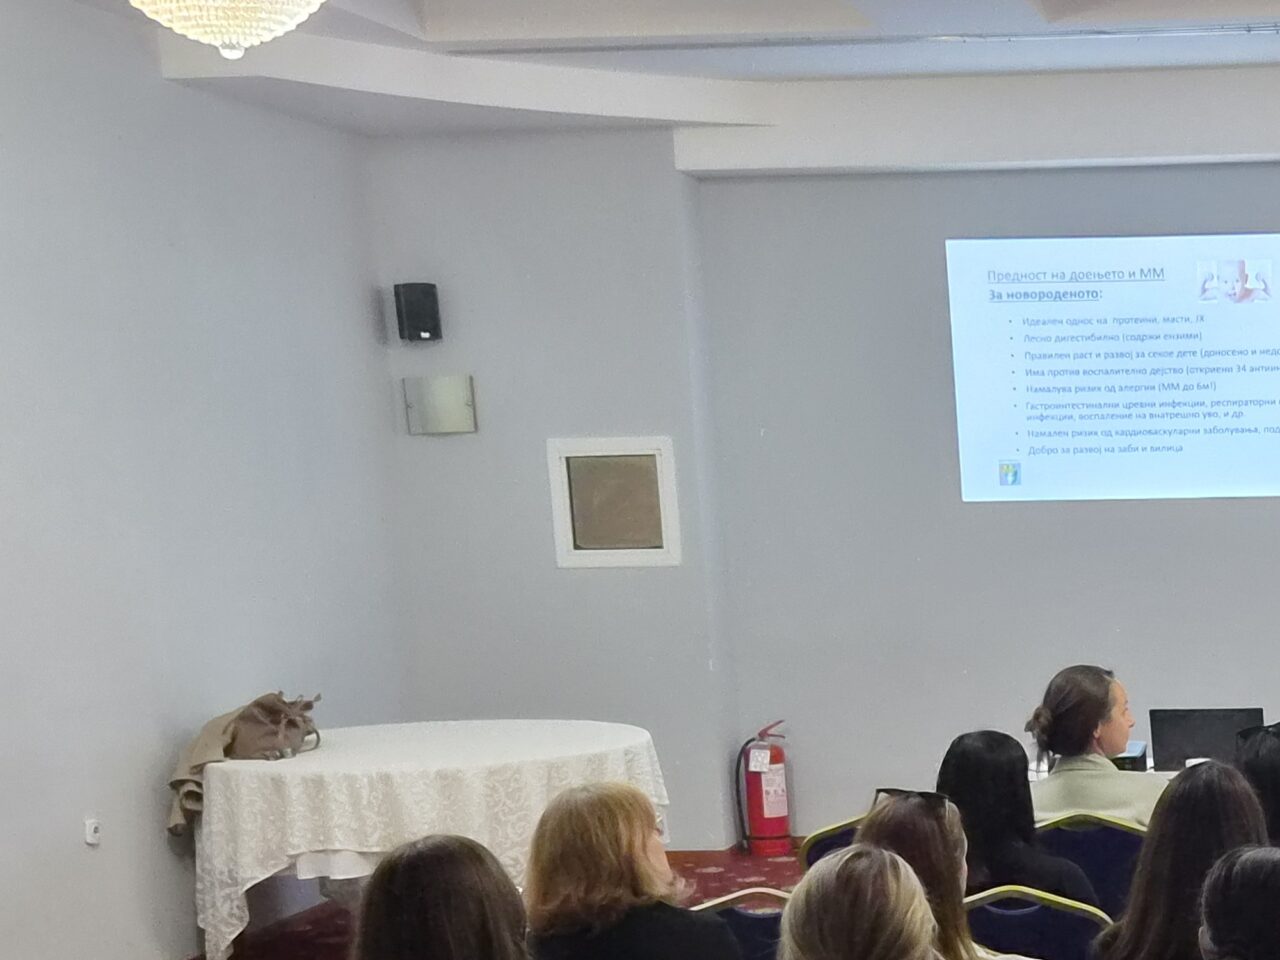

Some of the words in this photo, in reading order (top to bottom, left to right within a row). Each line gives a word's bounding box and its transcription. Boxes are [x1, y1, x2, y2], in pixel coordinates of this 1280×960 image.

[987, 270, 1048, 282] Предност
[1051, 271, 1066, 280] на
[1069, 270, 1125, 282] доењето
[1128, 270, 1136, 279] и
[1139, 267, 1165, 280] ММ
[989, 289, 1003, 300] За
[1006, 289, 1103, 301] новороденото:
[1065, 317, 1094, 326] однос
[1024, 334, 1052, 343] Лесно
[1024, 351, 1071, 361] Правилен
[1073, 351, 1093, 361] раст
[1103, 350, 1133, 361] развој
[1135, 350, 1145, 359] за
[1176, 349, 1198, 359] дете
[1025, 368, 1046, 377] Има
[1047, 368, 1080, 378] против
[1235, 364, 1247, 373] 34
[1104, 384, 1117, 393] од
[1181, 383, 1195, 392] до
[1135, 412, 1147, 420] на
[1100, 429, 1113, 438] од
[1028, 446, 1059, 456] Добро
[1060, 447, 1071, 455] за
[1072, 446, 1102, 457] развој
[1104, 446, 1115, 454] на
